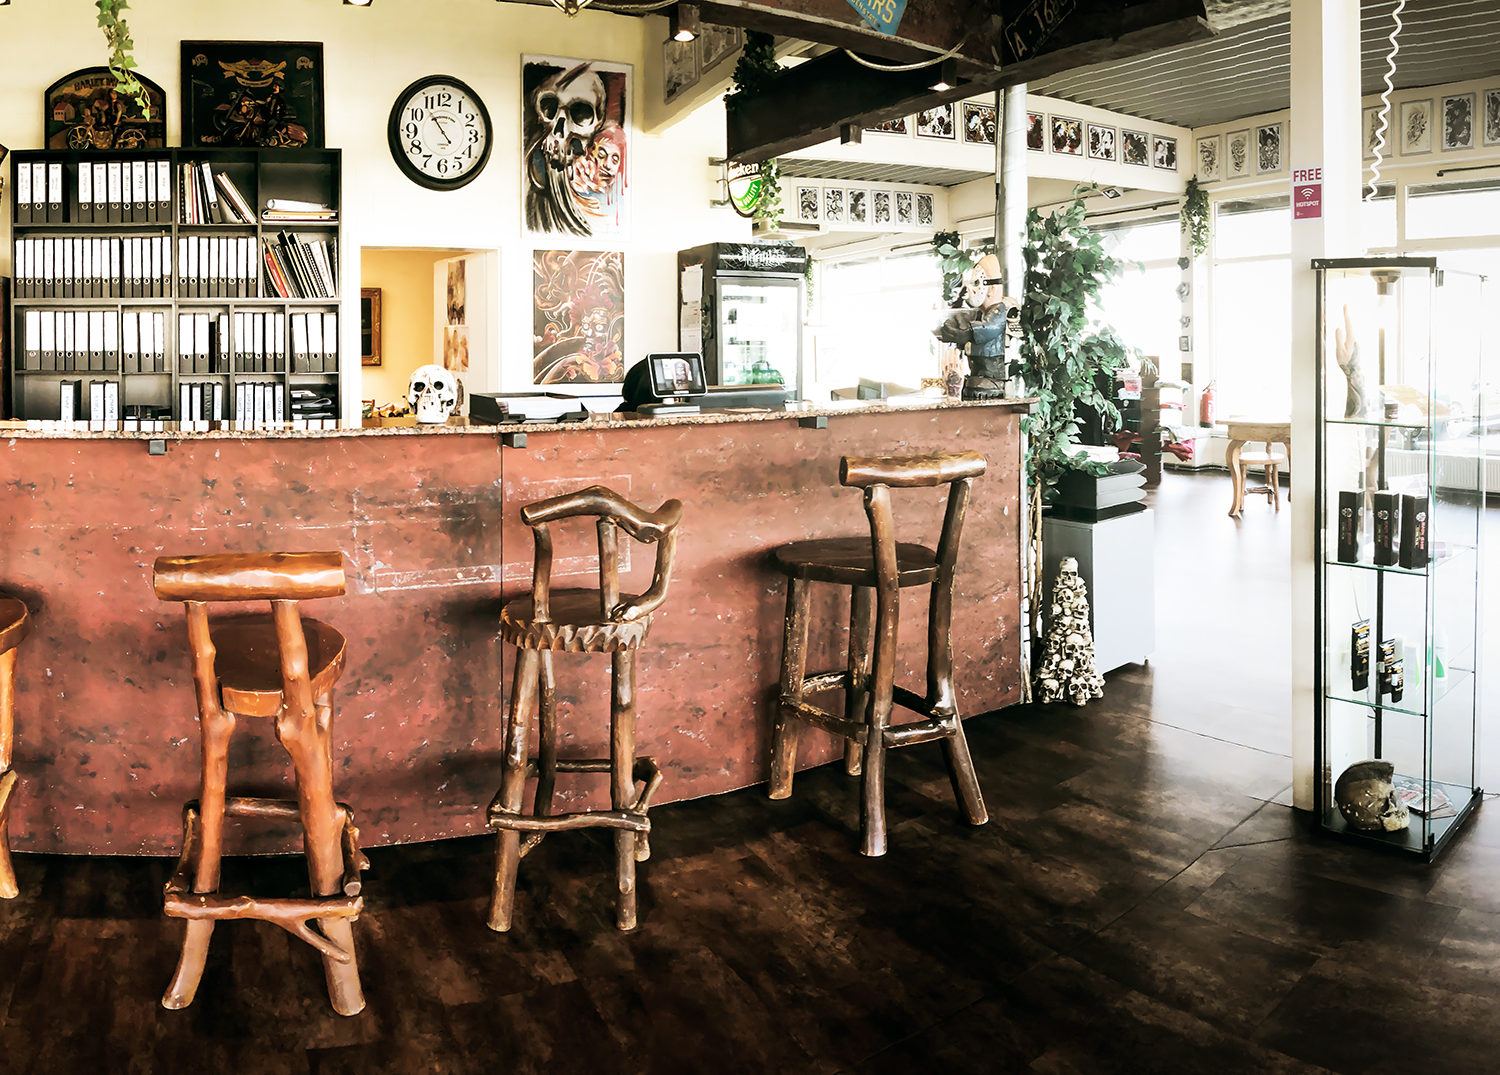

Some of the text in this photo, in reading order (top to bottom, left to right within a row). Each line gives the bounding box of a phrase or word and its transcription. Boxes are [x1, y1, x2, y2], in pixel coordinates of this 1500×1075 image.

[1014, 32, 1027, 57] A
[425, 96, 434, 109] 11
[437, 93, 451, 107] 12
[458, 100, 462, 113] 1
[411, 108, 423, 122] 10
[465, 113, 475, 127] 2
[406, 122, 418, 139] 9
[468, 129, 478, 143] 3
[410, 139, 422, 155] 8
[461, 144, 472, 158] 4
[422, 154, 432, 168] 7
[437, 158, 448, 173] 6
[452, 156, 462, 170] 5
[1293, 168, 1322, 182] FREE
